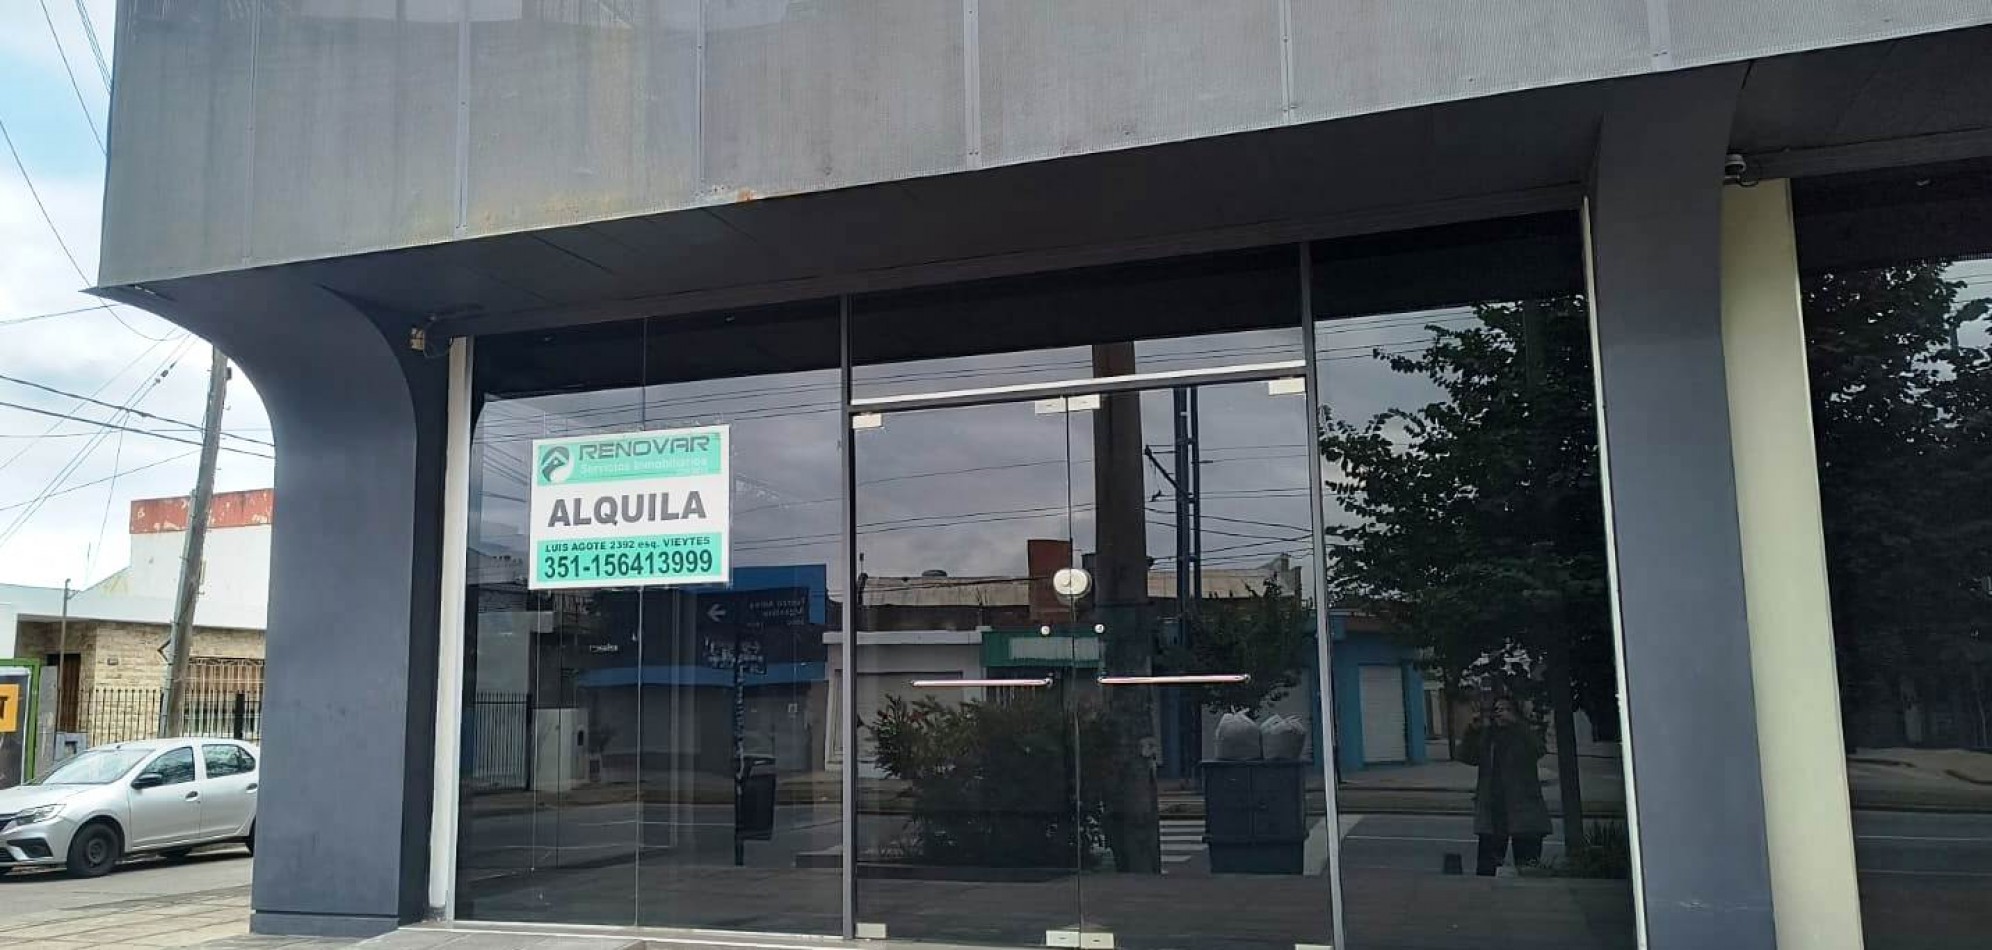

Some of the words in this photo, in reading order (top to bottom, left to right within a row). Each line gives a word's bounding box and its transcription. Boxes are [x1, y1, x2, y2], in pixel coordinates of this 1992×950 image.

[579, 436, 710, 460] RENOVAR
[580, 461, 630, 475] Servicios
[548, 490, 706, 527] ALQUILA
[545, 543, 568, 552] LUIS
[571, 541, 606, 551] AGOTE
[610, 540, 635, 549] 2392
[638, 540, 660, 550] esq.
[663, 536, 711, 547] VIEYTES
[544, 549, 713, 579] 351-156413999
